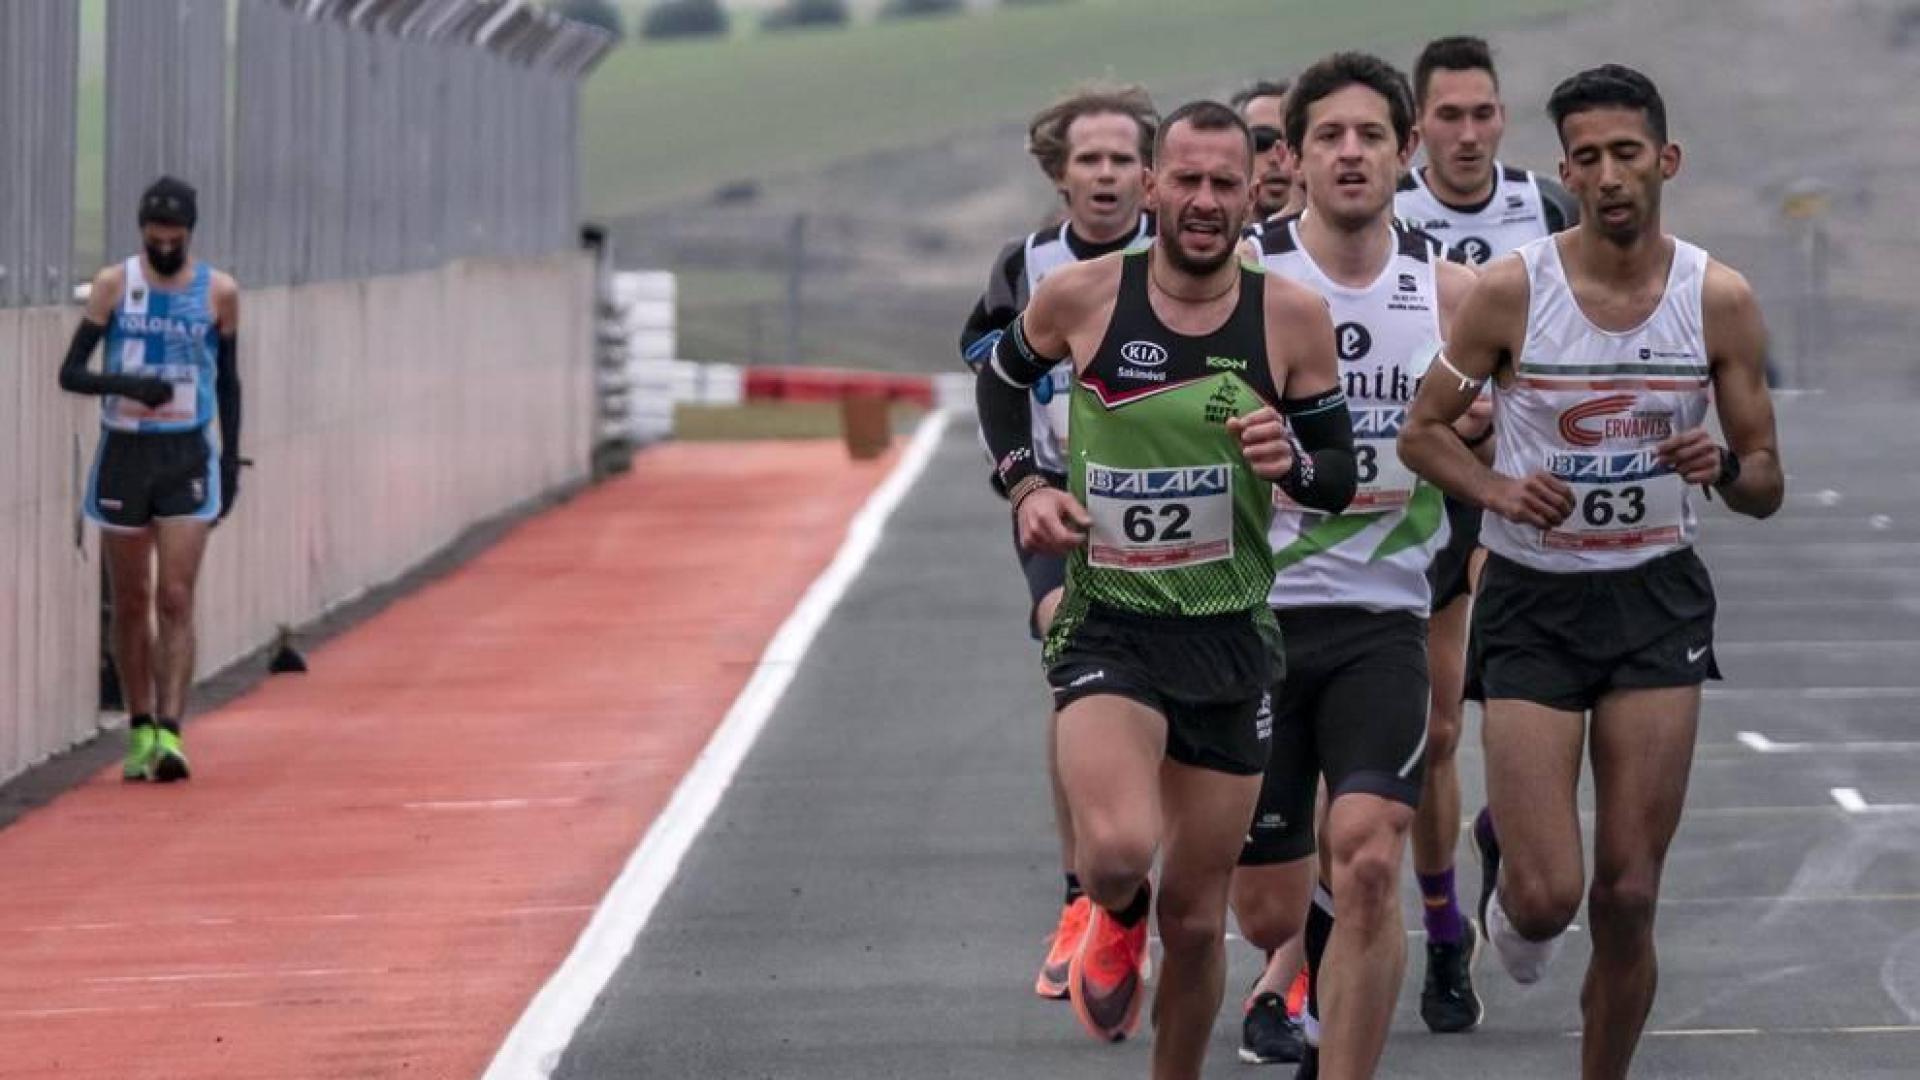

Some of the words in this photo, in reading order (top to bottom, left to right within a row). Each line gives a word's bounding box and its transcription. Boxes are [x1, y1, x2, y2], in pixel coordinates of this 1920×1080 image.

[1128, 344, 1159, 363] KIA
[1123, 503, 1192, 543] 62
[1582, 486, 1646, 526] 63
